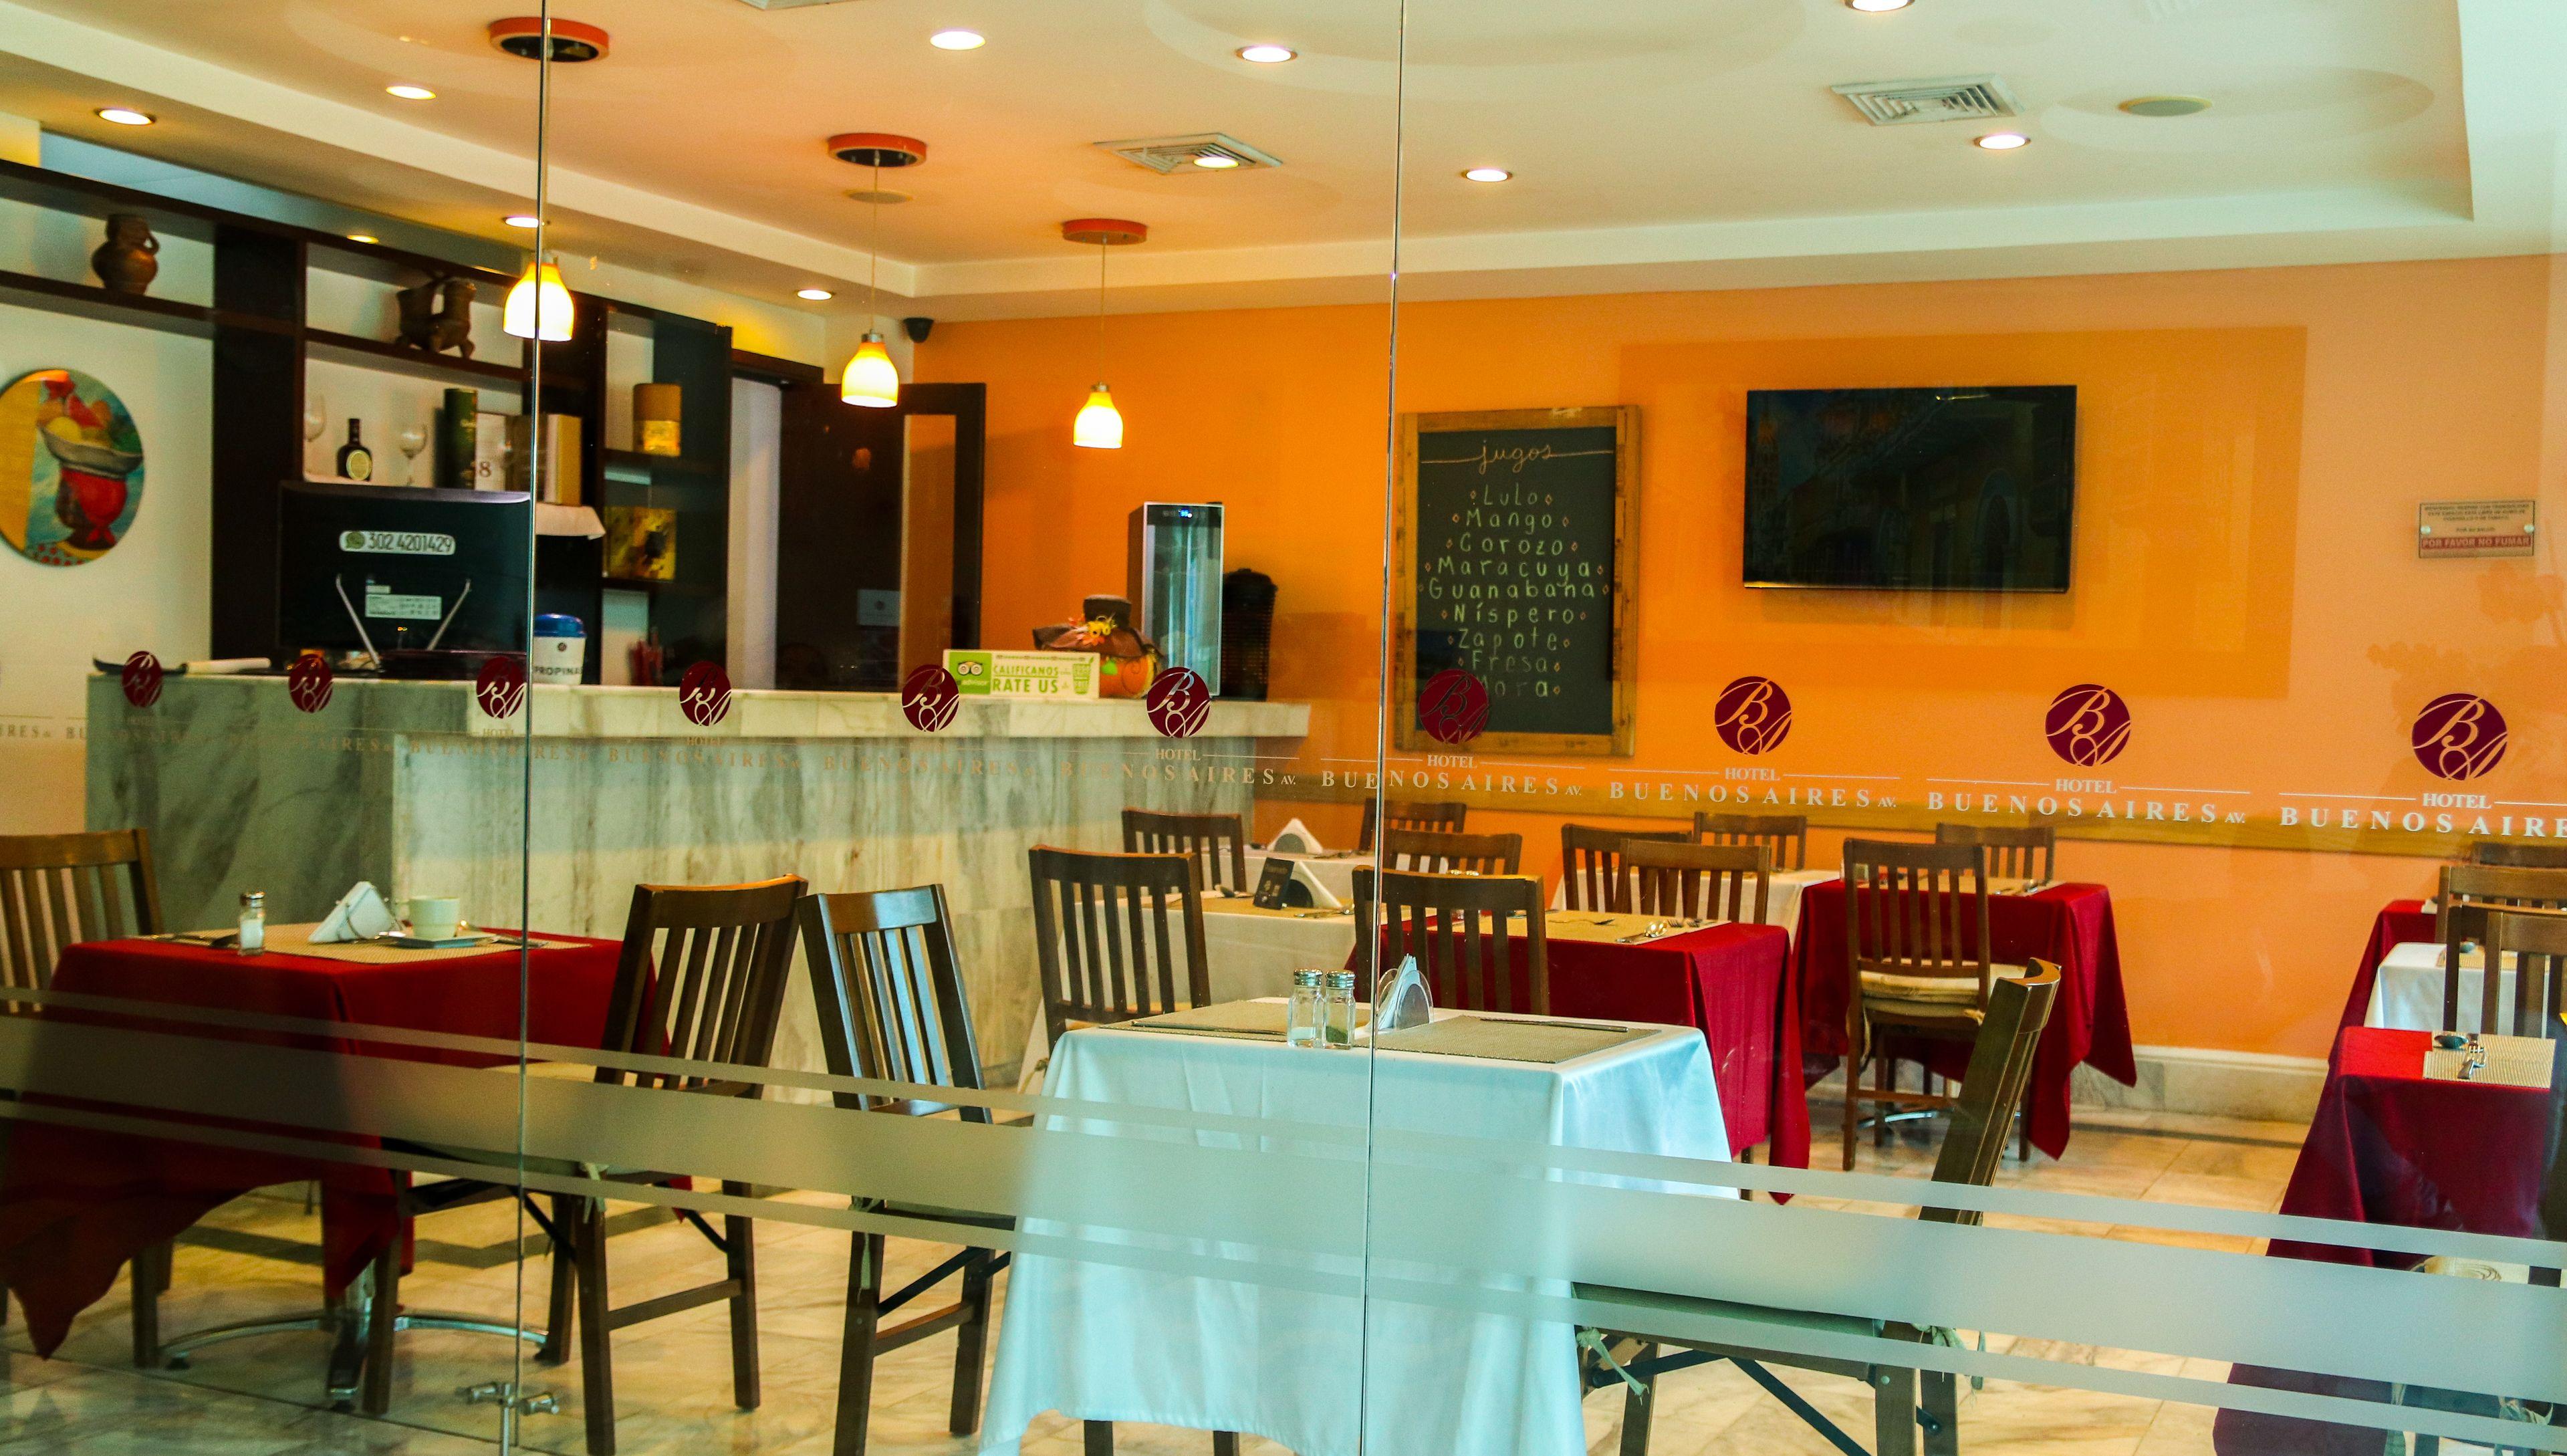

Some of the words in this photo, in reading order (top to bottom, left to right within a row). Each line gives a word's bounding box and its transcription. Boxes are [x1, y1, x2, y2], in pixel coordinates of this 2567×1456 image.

[1475, 440, 1552, 475] jugos
[1465, 508, 1552, 535] Mango
[368, 533, 393, 550] 302
[397, 534, 451, 552] 4201429
[1459, 532, 1564, 556] Corozo
[2494, 535, 2531, 547] FUMAR
[1437, 556, 1590, 587] Maracuya
[1429, 577, 1595, 599] Guanabana
[1453, 602, 1574, 628] Níspero
[1458, 626, 1558, 655] Zapote
[993, 665, 1059, 677] CALIFICANOS
[1471, 650, 1548, 673] Fresa
[993, 679, 1031, 693] RATE
[1038, 680, 1058, 694] US
[1155, 748, 1201, 761] HOTEL
[1427, 754, 1478, 769] HOTEL
[1725, 767, 1780, 781] HOTEL
[2055, 778, 2117, 794] HOTEL
[2422, 793, 2493, 810] HOTEL
